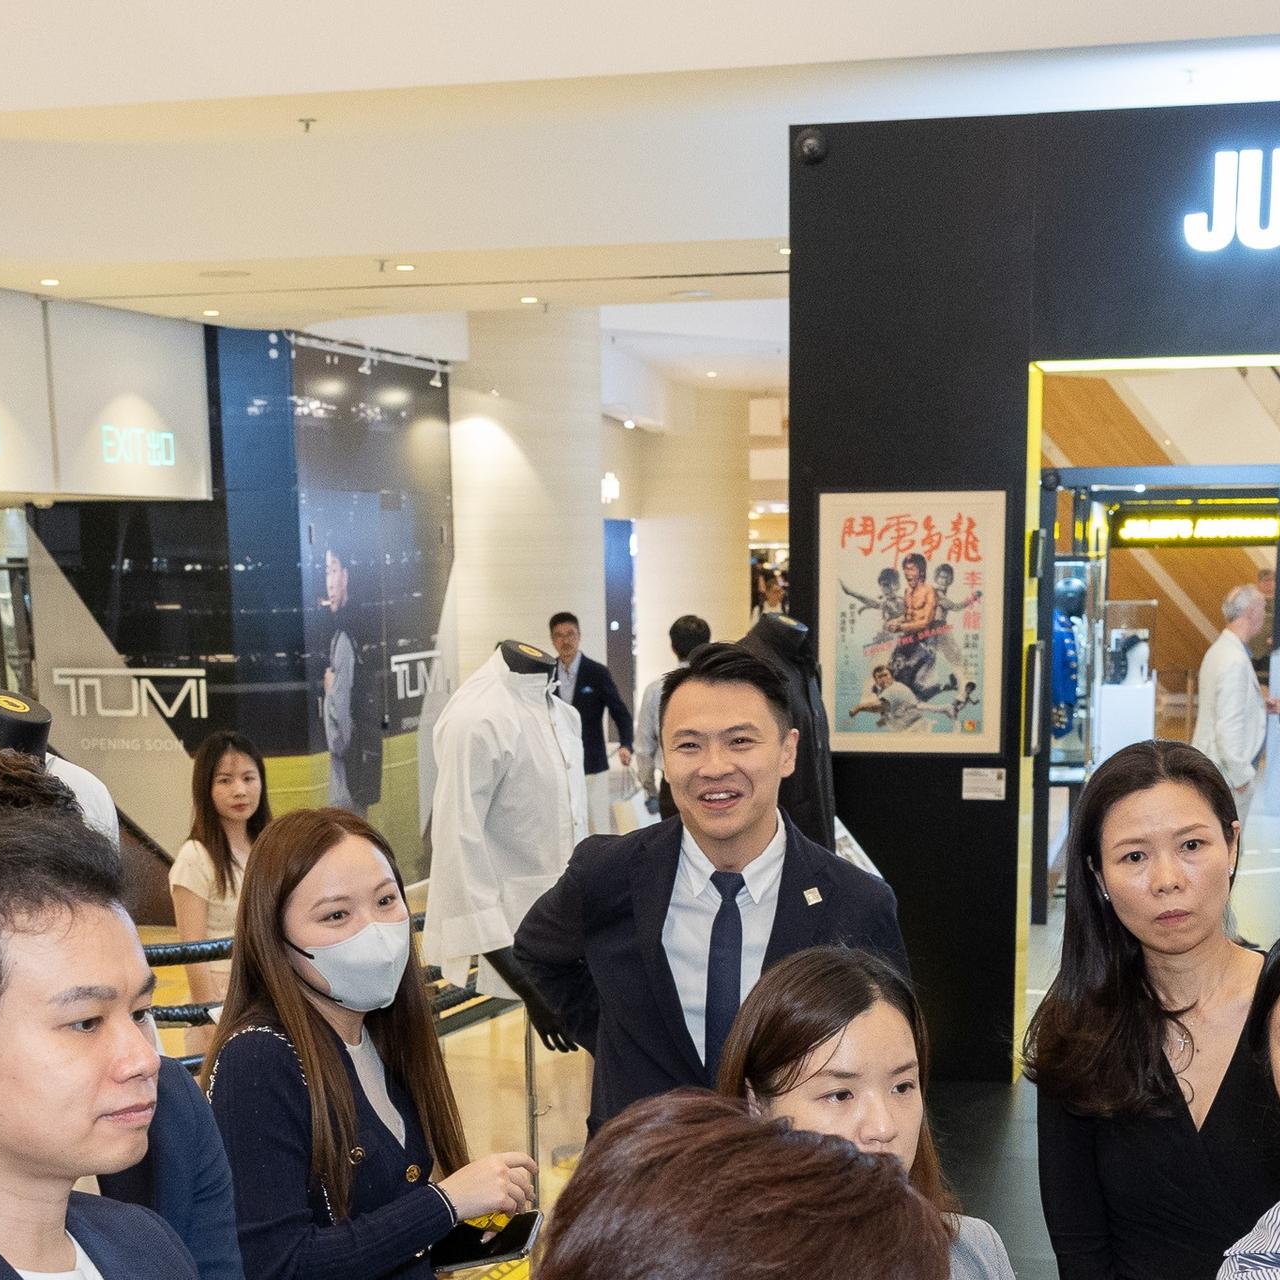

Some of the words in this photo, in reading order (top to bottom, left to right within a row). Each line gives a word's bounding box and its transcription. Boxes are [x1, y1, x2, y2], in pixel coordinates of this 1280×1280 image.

[101, 423, 145, 465] EXIT
[146, 431, 176, 467] 出口
[53, 667, 209, 719] TUMI
[391, 649, 442, 700] TUM
